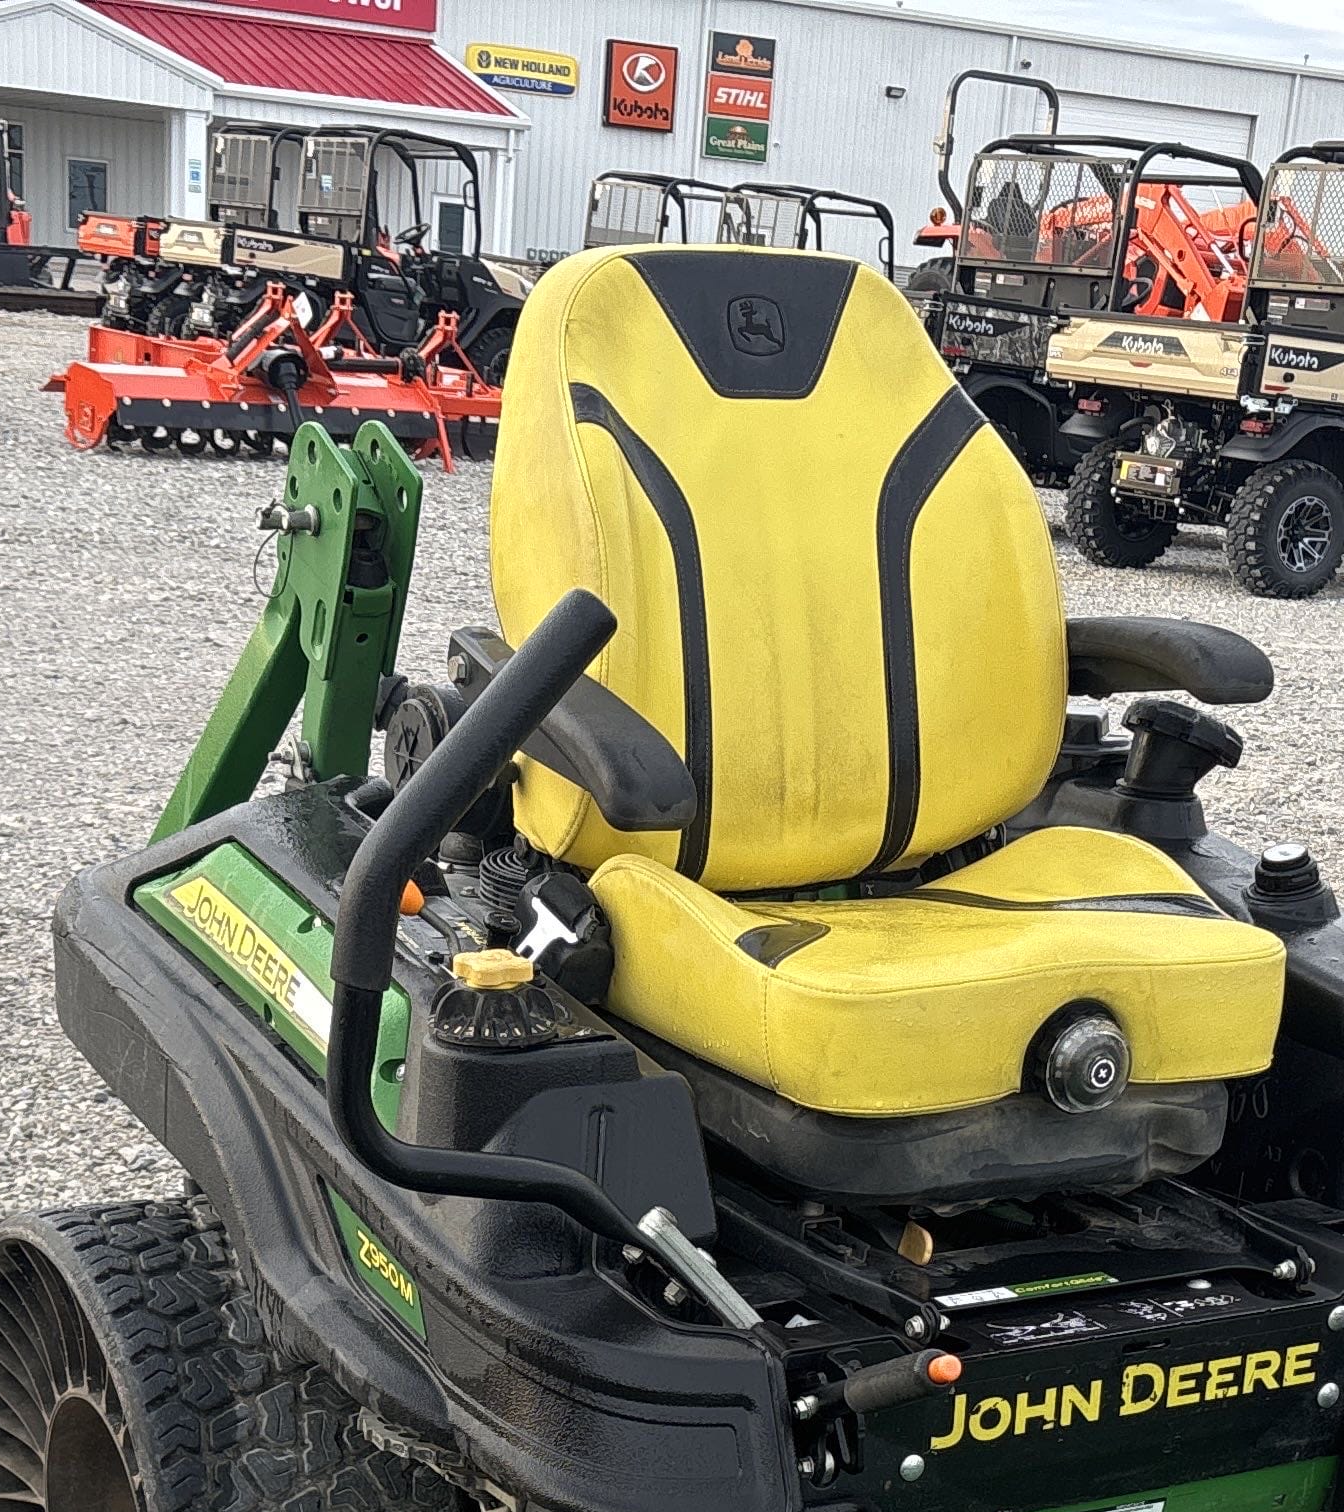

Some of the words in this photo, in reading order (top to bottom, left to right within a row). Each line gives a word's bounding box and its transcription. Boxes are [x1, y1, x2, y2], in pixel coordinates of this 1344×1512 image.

[494, 56, 519, 70] NEW
[521, 60, 571, 77] HOLLAND
[613, 97, 669, 121] Kubota
[714, 87, 768, 109] STIHL
[709, 136, 736, 149] Great
[736, 138, 765, 152] Plains
[237, 237, 274, 252] Kubota
[948, 314, 994, 335] Kubota
[1121, 335, 1164, 355] Kubota
[1271, 347, 1319, 369] Kubota
[187, 885, 239, 949] JOHN
[237, 924, 301, 1009] DEERE
[357, 1228, 414, 1308] Z950M
[930, 1379, 1103, 1451] JOHN
[1119, 1342, 1321, 1417] DEERE
